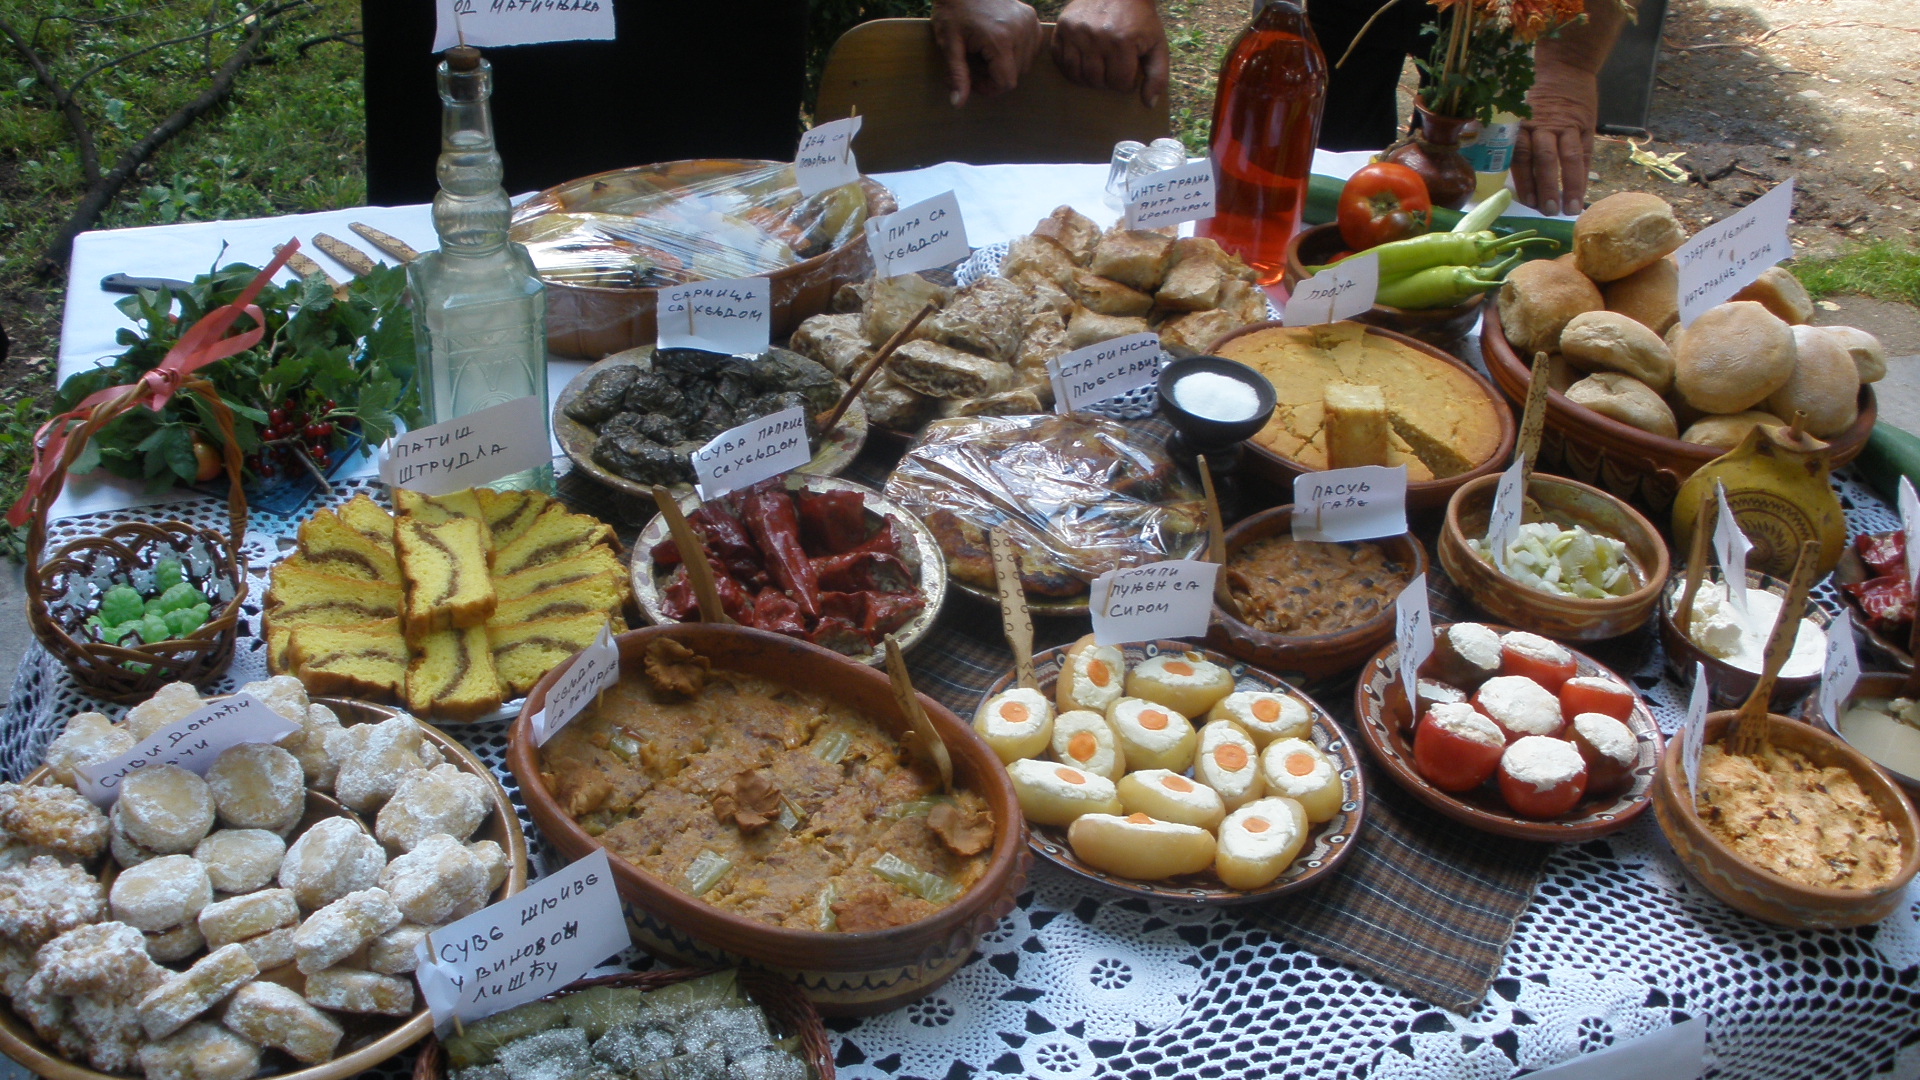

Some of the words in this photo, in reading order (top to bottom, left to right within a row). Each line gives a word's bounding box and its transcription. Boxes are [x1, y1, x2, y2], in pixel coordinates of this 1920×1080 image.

[1184, 191, 1202, 200] СА
[888, 218, 921, 243] ПИТА
[929, 208, 947, 222] СА
[672, 288, 757, 302] САРМИЦА
[668, 304, 685, 313] СА
[700, 438, 746, 462] СУВА
[399, 443, 508, 485] ШТРУДЛА
[1109, 603, 1169, 618] СИРОМ
[440, 926, 504, 965] СУВЕ
